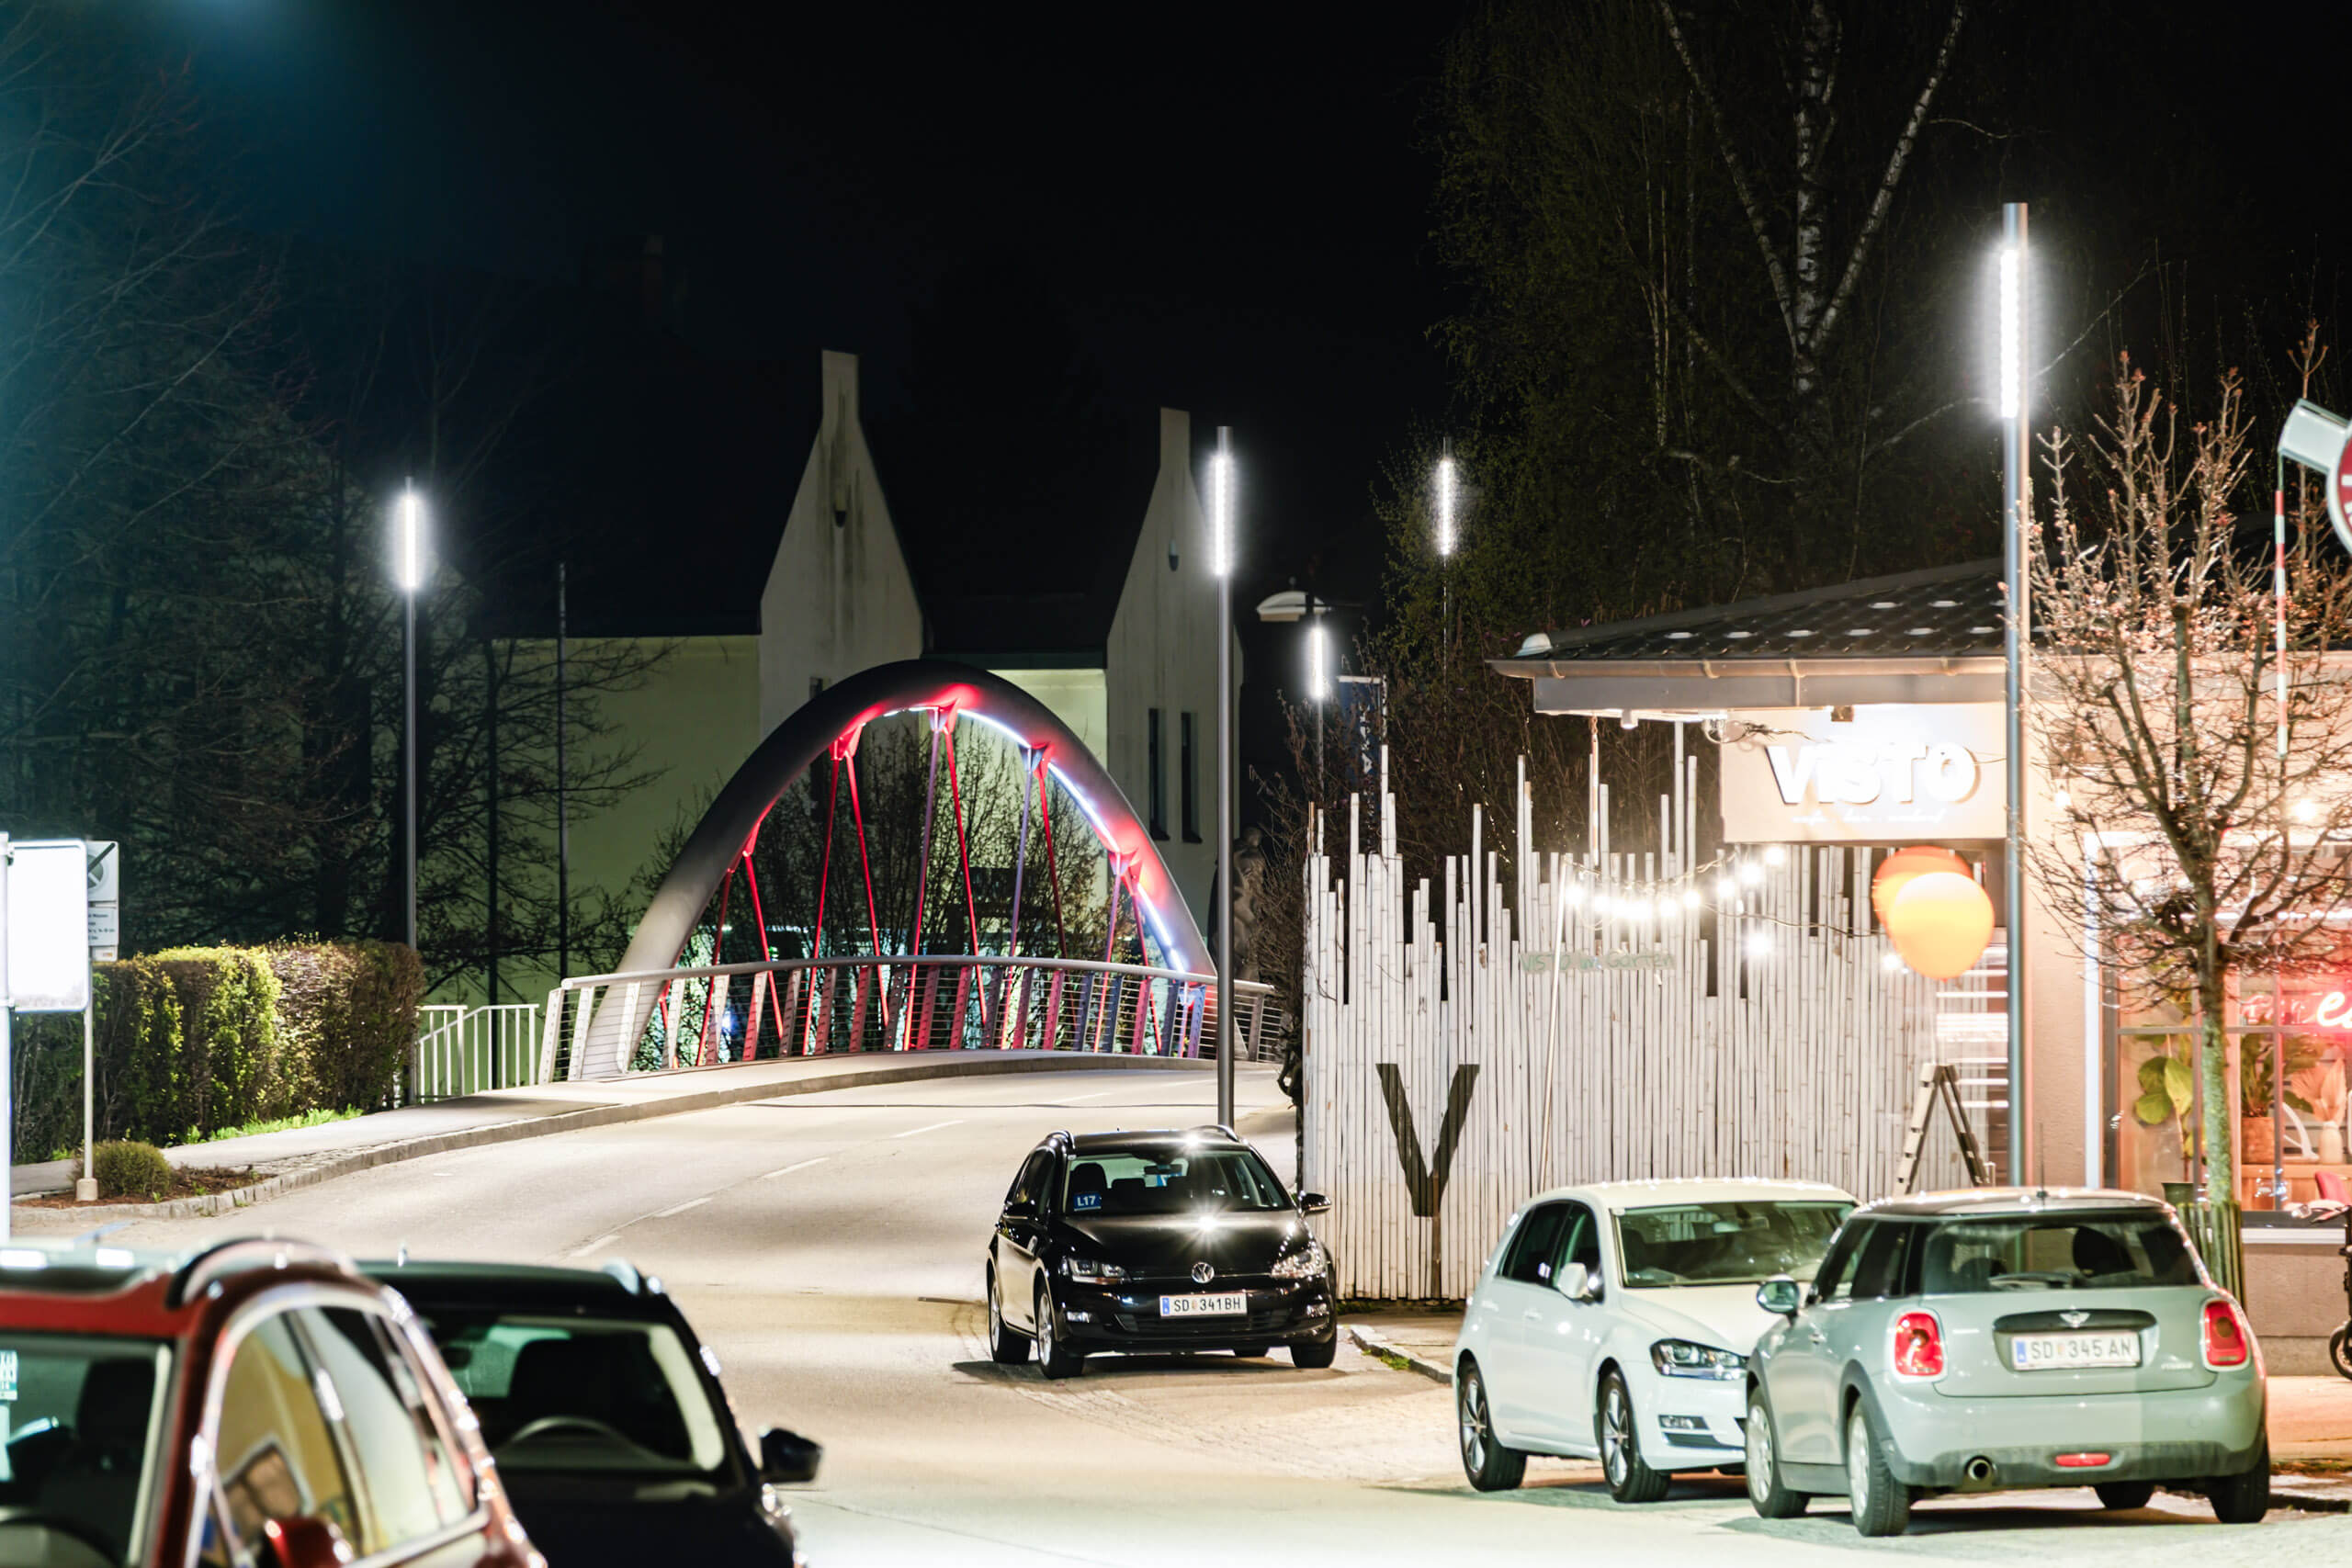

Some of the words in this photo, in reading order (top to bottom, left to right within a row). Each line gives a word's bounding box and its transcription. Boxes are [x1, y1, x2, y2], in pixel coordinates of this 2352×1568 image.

[1765, 741, 1981, 805] VISTO
[1375, 1063, 1480, 1217] V
[1077, 1195, 1096, 1206] L17
[1174, 1299, 1190, 1312] SD
[2030, 1342, 2052, 1359] SD
[2068, 1339, 2102, 1358] 345
[2109, 1337, 2132, 1356] AN
